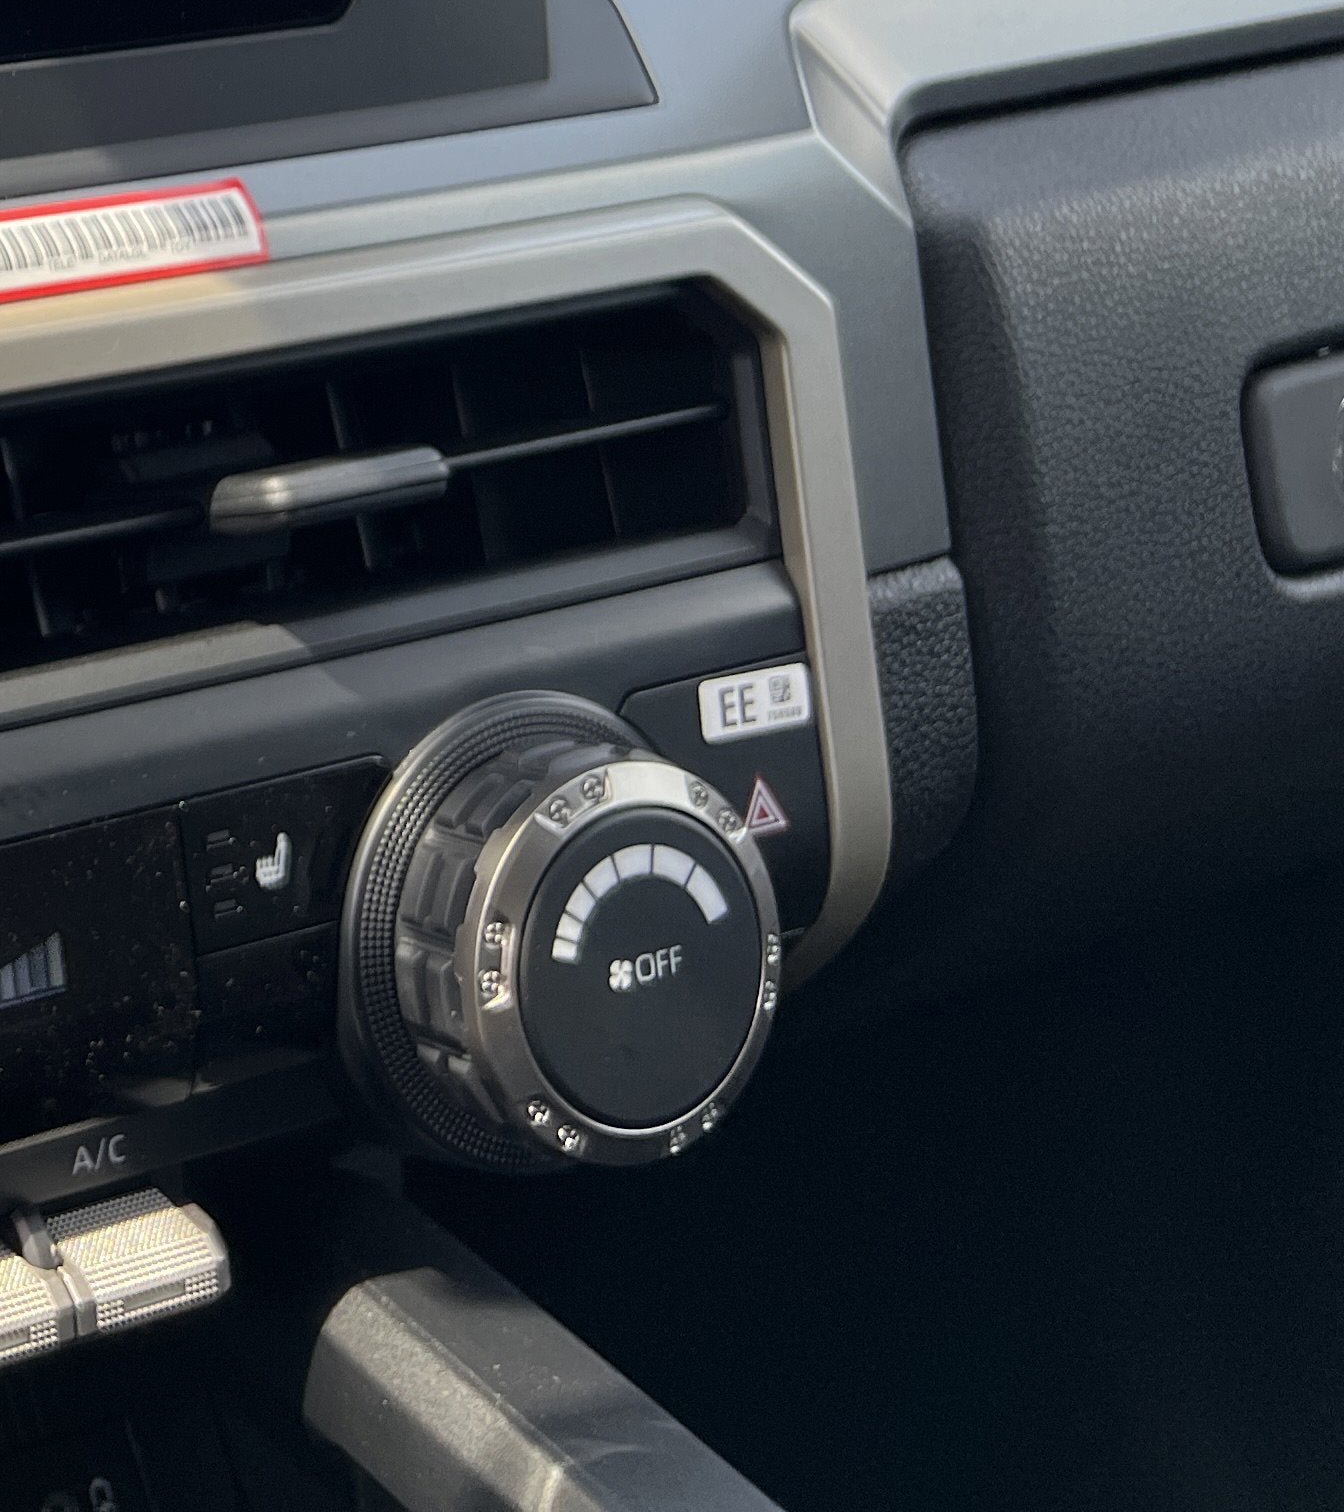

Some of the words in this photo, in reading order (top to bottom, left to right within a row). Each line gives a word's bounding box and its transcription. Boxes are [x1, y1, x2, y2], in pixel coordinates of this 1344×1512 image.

[718, 683, 757, 727] EE
[635, 945, 683, 984] OFF
[72, 1134, 127, 1176] A/C
